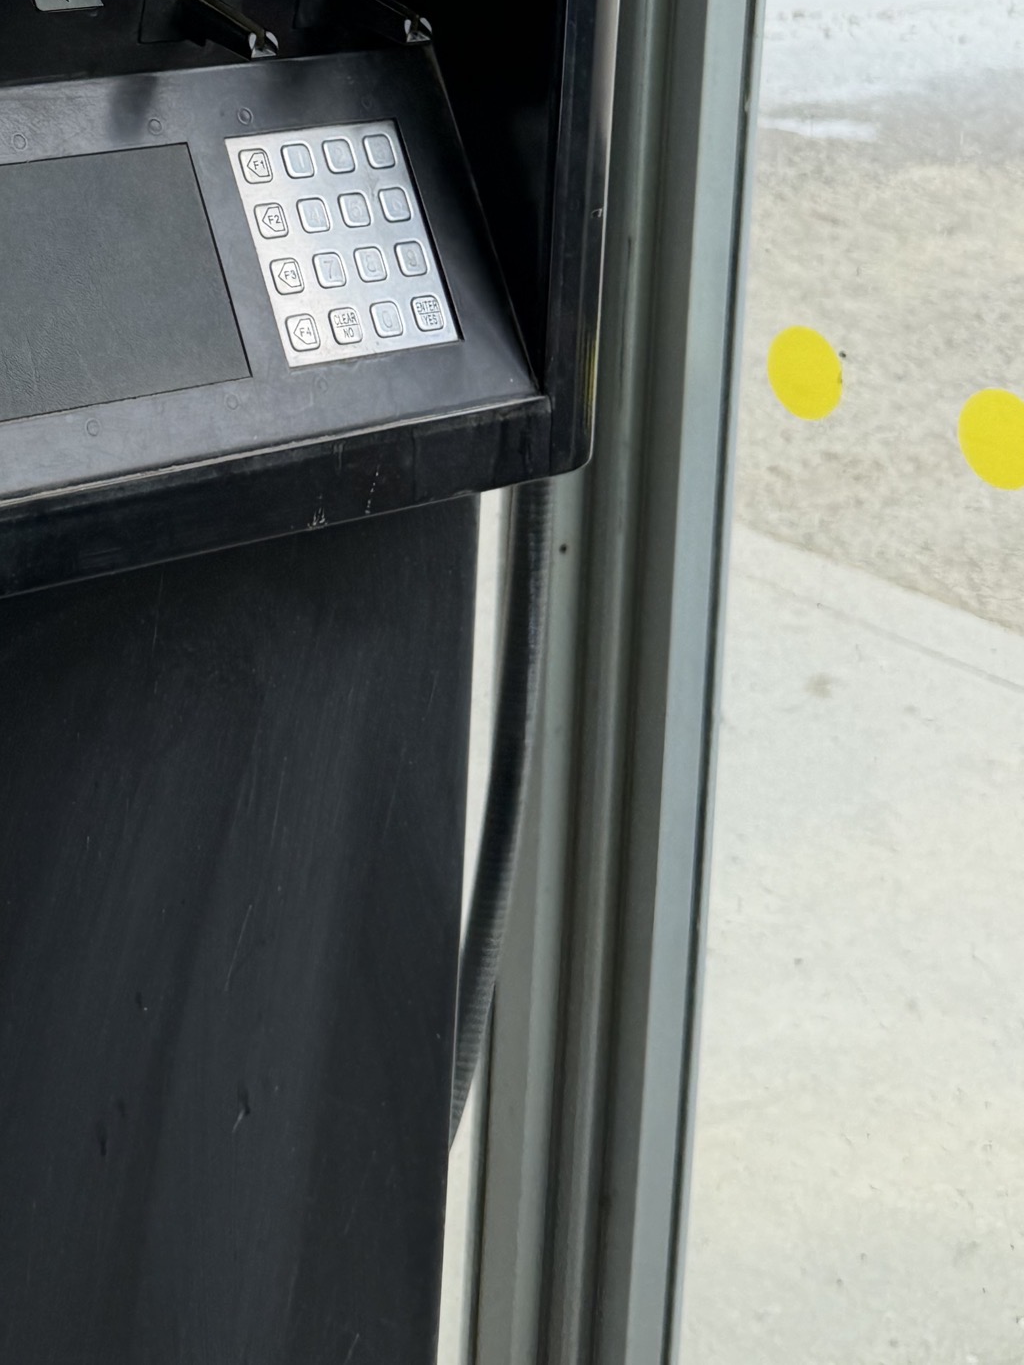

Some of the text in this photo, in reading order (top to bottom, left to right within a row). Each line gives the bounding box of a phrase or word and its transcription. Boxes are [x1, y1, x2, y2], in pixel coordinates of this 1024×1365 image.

[253, 158, 267, 171] F1
[267, 214, 281, 225] F2
[406, 249, 419, 268] 9
[284, 270, 297, 281] F3
[323, 260, 334, 279] 7
[415, 299, 439, 312] ENTER
[334, 311, 357, 325] CLEAR
[423, 313, 438, 326] YES
[299, 325, 313, 337] F4
[343, 327, 355, 339] NO
